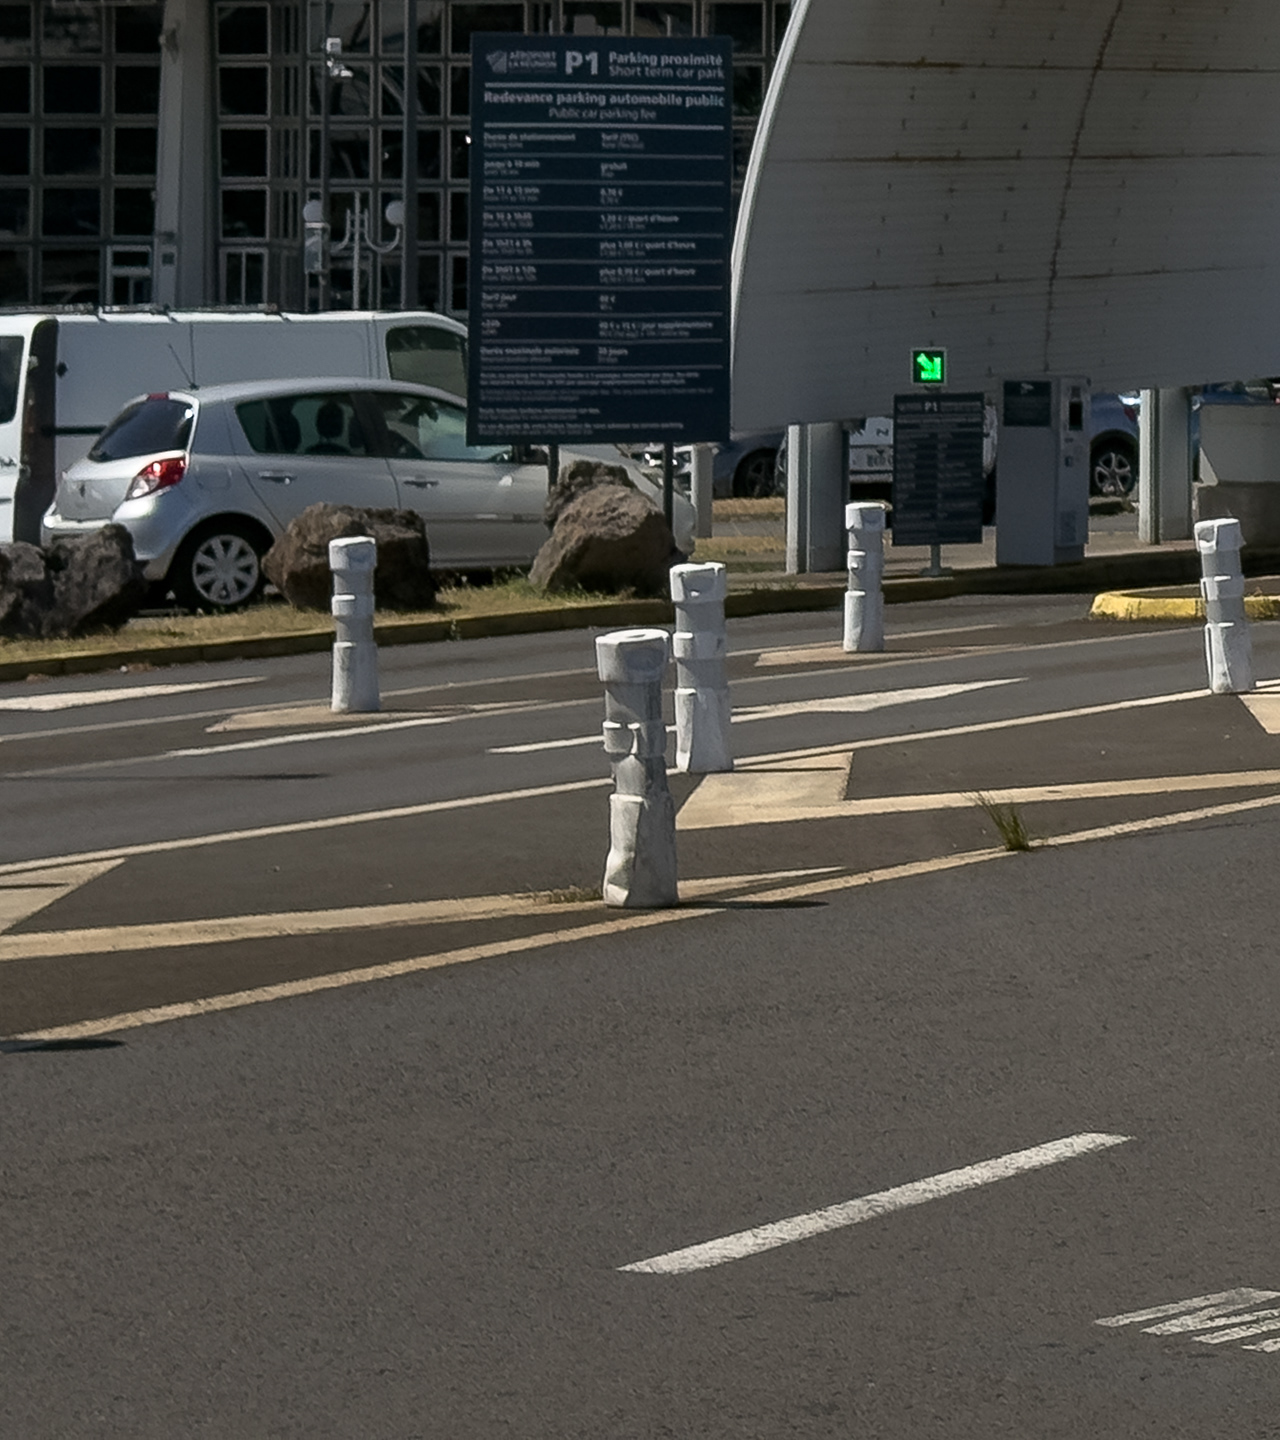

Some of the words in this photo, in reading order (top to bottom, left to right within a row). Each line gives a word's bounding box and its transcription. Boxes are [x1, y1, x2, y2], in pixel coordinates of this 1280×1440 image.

[565, 50, 599, 76] P1
[609, 51, 658, 68] Parking
[660, 51, 724, 70] proximité
[609, 66, 642, 77] Short
[647, 67, 675, 78] term
[676, 68, 695, 79] car
[697, 67, 725, 81] park
[484, 91, 555, 103] Redevance
[556, 92, 606, 107] parking
[609, 93, 682, 106] automobile
[685, 94, 725, 108] public
[548, 108, 579, 118] Public
[581, 109, 599, 119] car
[600, 109, 640, 122] parking
